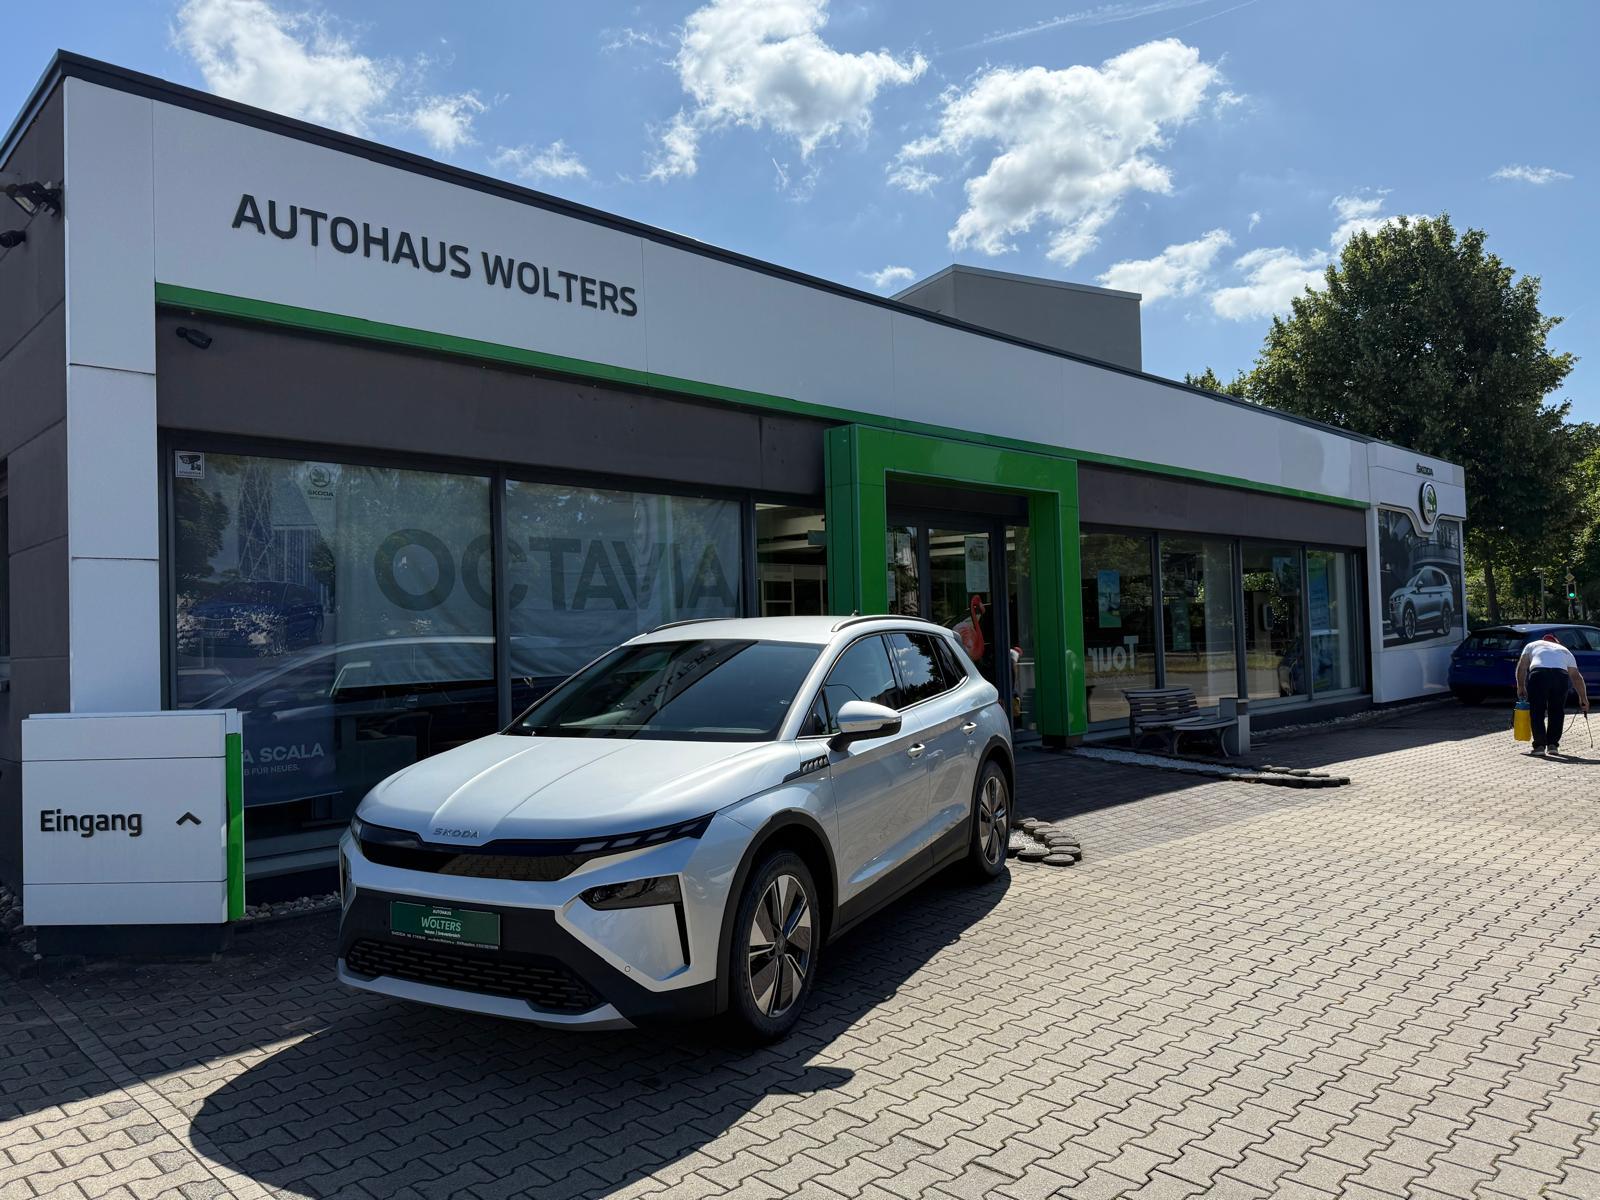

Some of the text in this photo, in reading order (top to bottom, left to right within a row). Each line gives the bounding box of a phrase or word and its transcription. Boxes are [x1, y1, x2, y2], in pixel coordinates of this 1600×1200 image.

[231, 194, 638, 318] AUTOHAUS WOLTERS
[374, 528, 737, 612] OCTAVIA
[260, 742, 325, 763] SCALA
[40, 809, 143, 838] Eingang
[421, 916, 462, 932] WOLTERS
